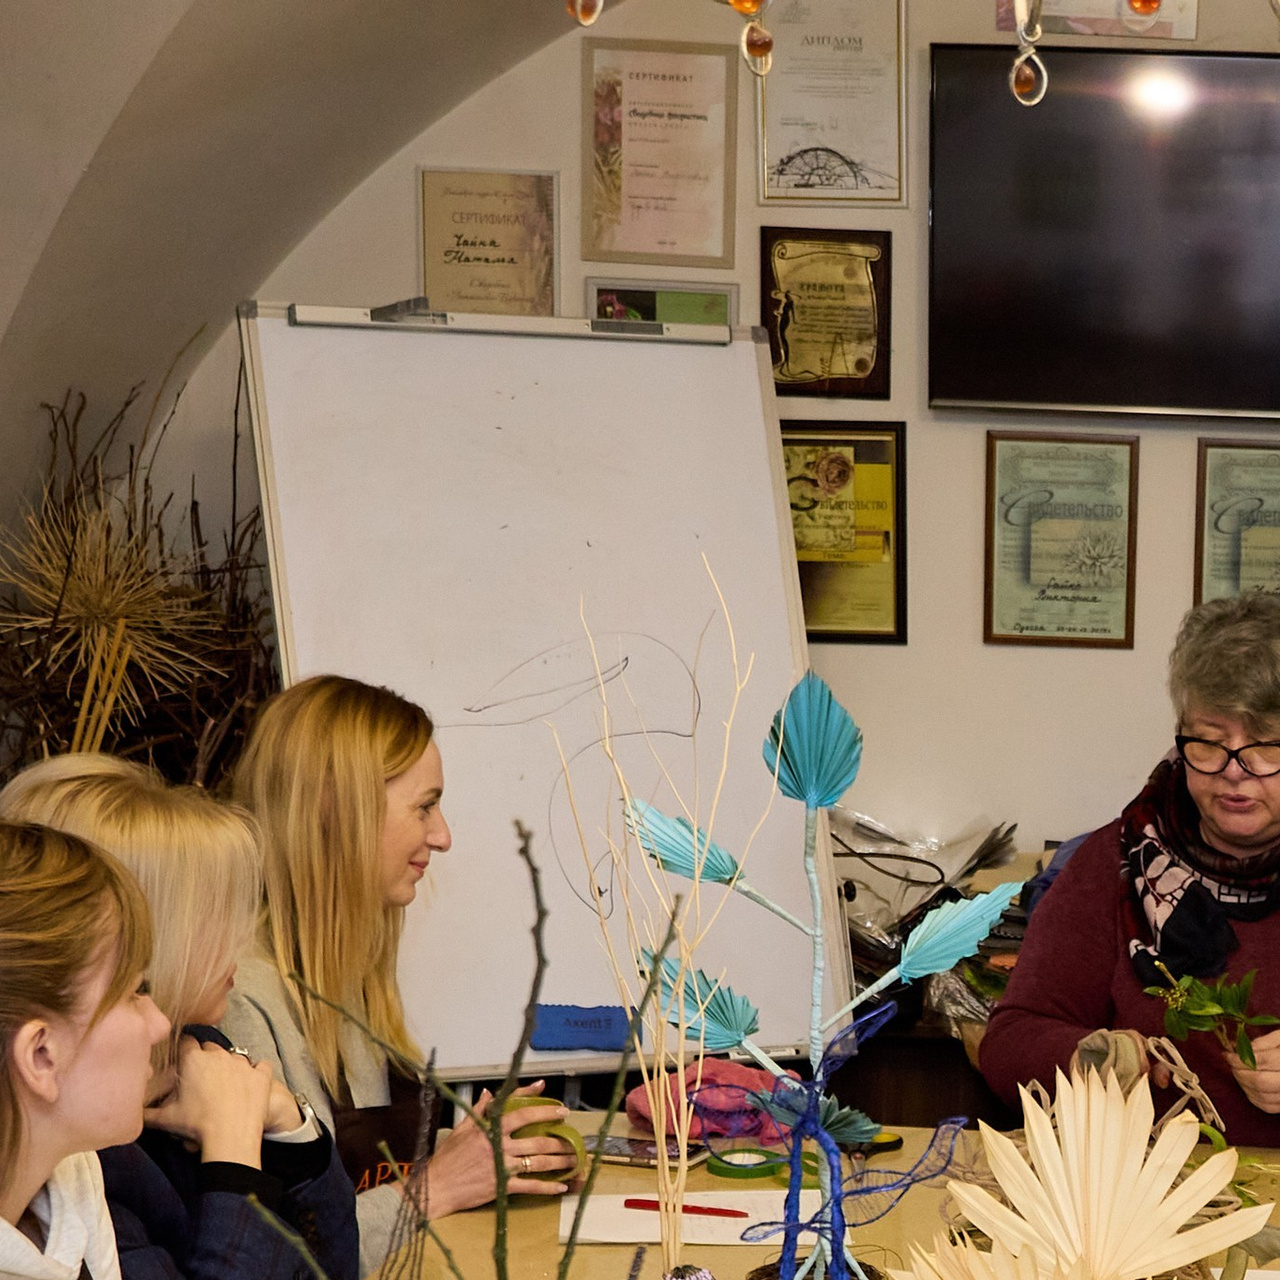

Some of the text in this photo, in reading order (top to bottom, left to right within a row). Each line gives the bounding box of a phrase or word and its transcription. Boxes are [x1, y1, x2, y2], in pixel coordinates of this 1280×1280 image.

[801, 35, 863, 46] ДИПЛОМ
[628, 72, 694, 83] СЕРТИФИКАТ
[452, 211, 528, 226] СЕРТИФИКАТ
[356, 1162, 414, 1193] АРТ
